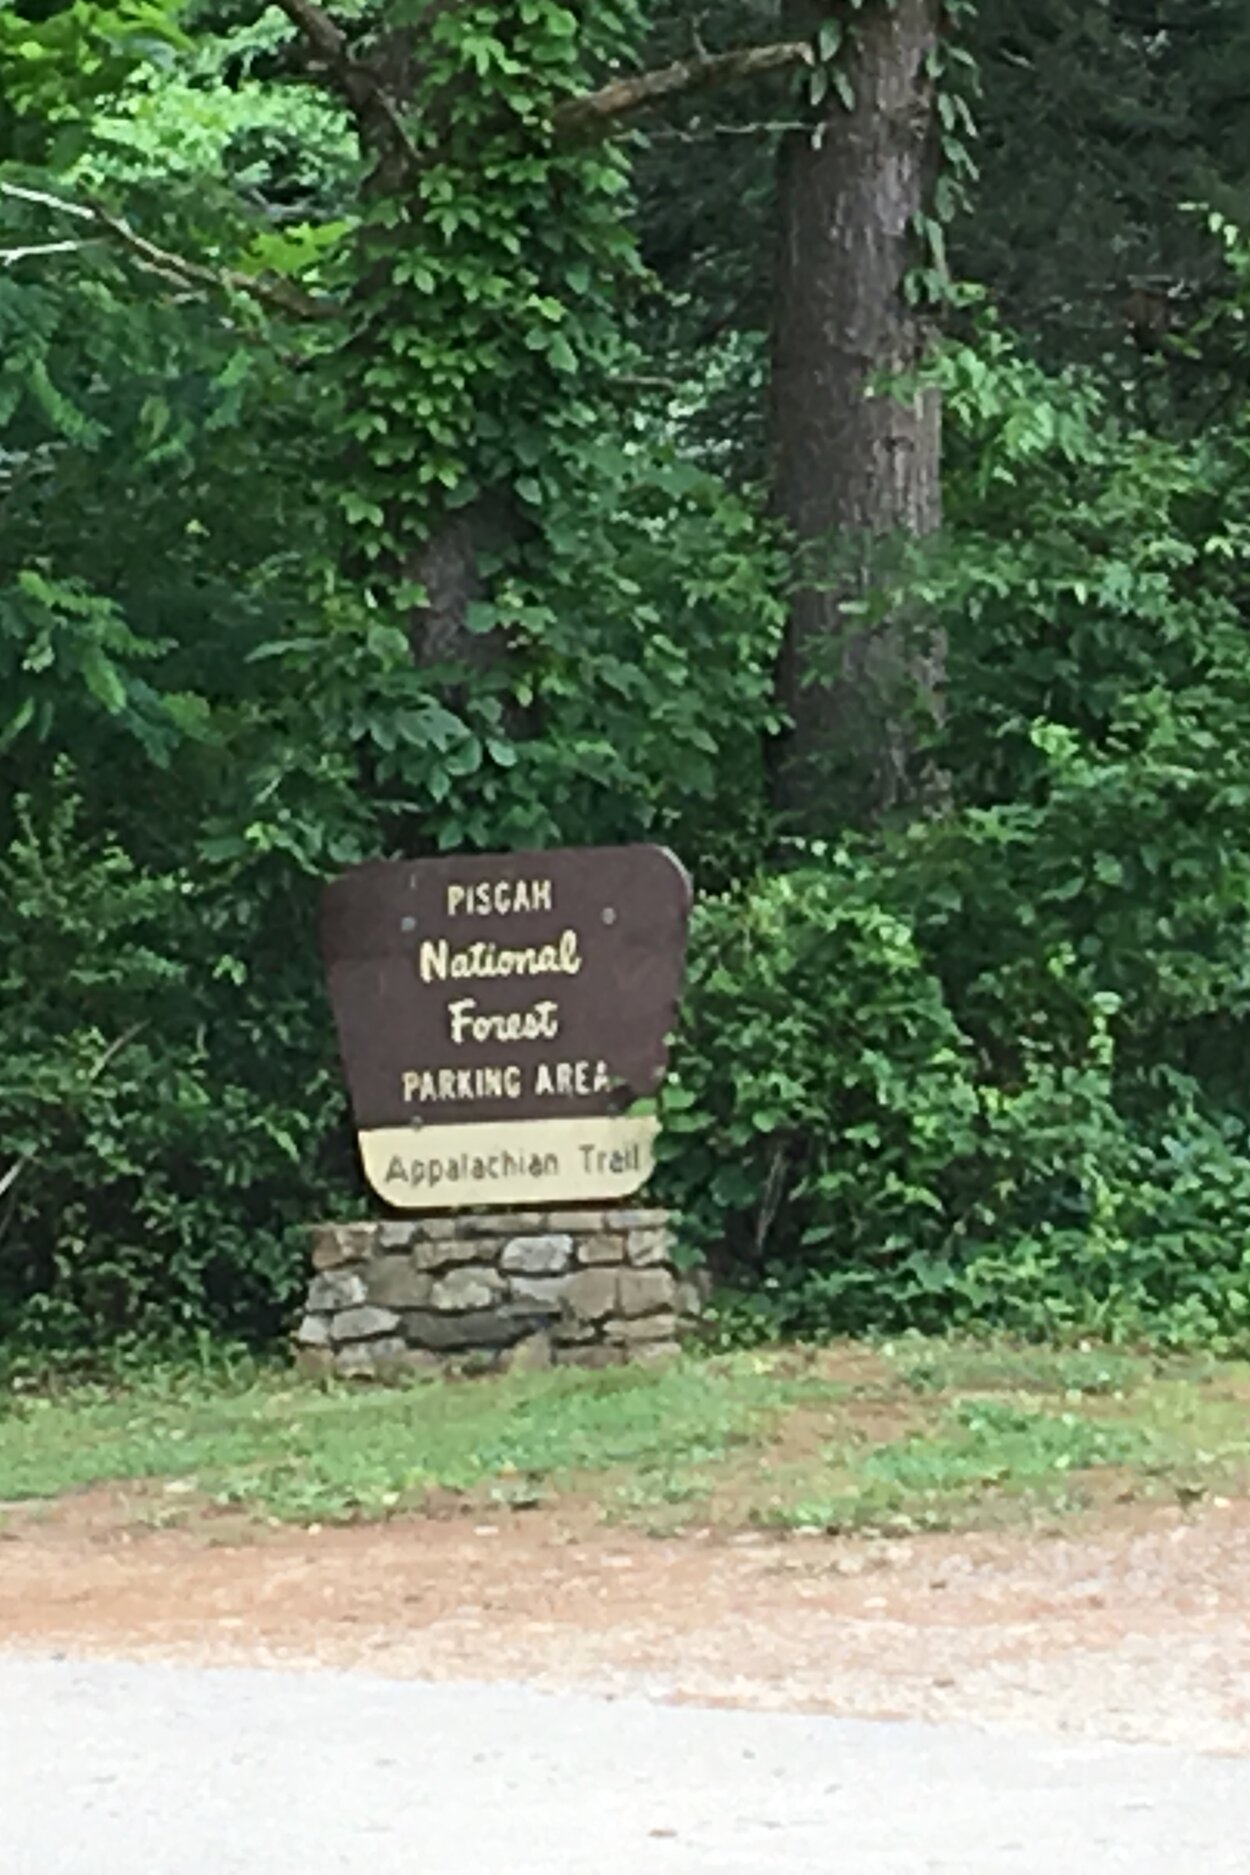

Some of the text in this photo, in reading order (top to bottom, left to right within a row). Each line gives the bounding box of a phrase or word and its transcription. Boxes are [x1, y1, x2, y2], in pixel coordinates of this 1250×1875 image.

[446, 879, 553, 917] PISGAH
[419, 929, 582, 983] National
[447, 997, 559, 1044] Forest
[402, 1060, 612, 1102] PARKING AREA
[384, 1143, 640, 1187] Appalachian Trail
